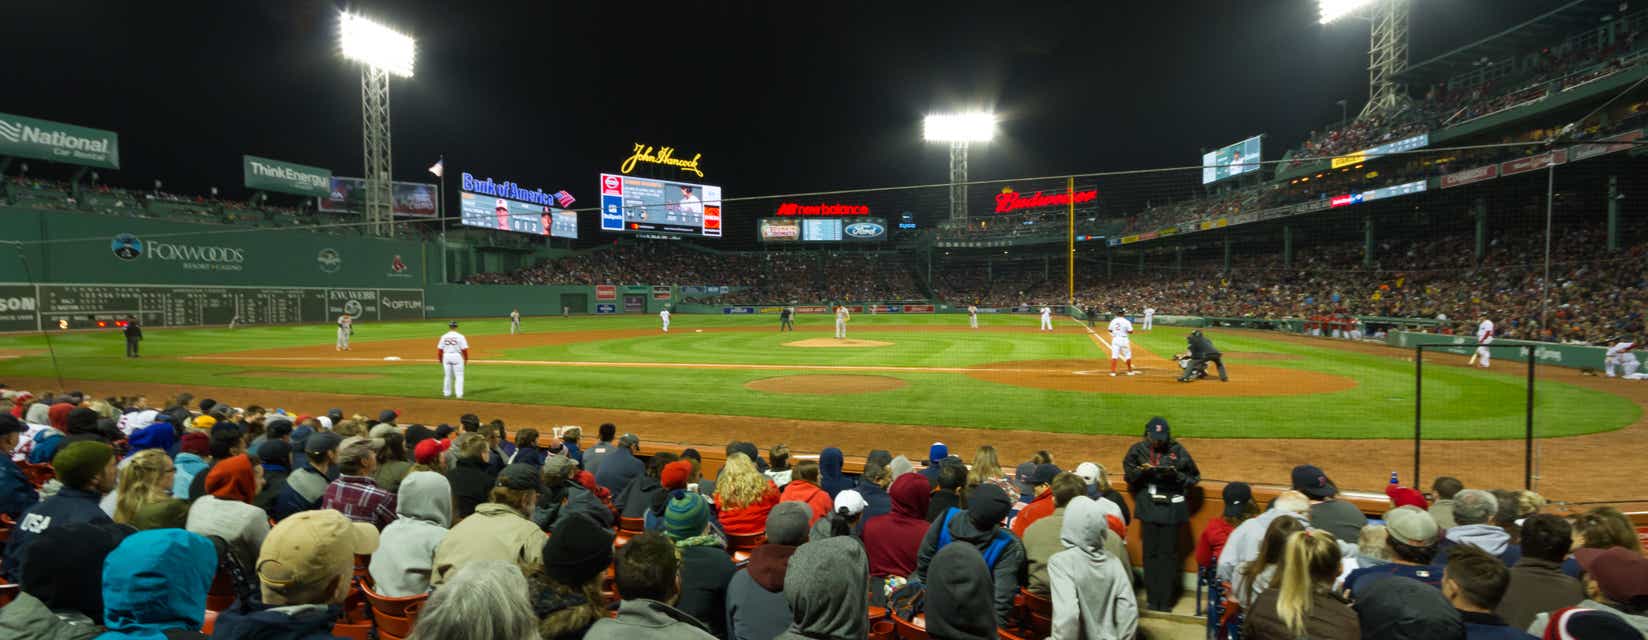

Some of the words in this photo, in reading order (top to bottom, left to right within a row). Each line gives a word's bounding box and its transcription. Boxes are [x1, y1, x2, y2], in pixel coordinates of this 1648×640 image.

[22, 126, 109, 152] National
[621, 143, 656, 174] John
[654, 146, 704, 178] Hancock
[462, 172, 497, 196] Bank
[497, 181, 509, 198] of
[510, 183, 554, 206] America
[851, 224, 876, 236] Ford
[146, 240, 245, 263] FOXWOODS
[391, 300, 422, 310] OPTUM
